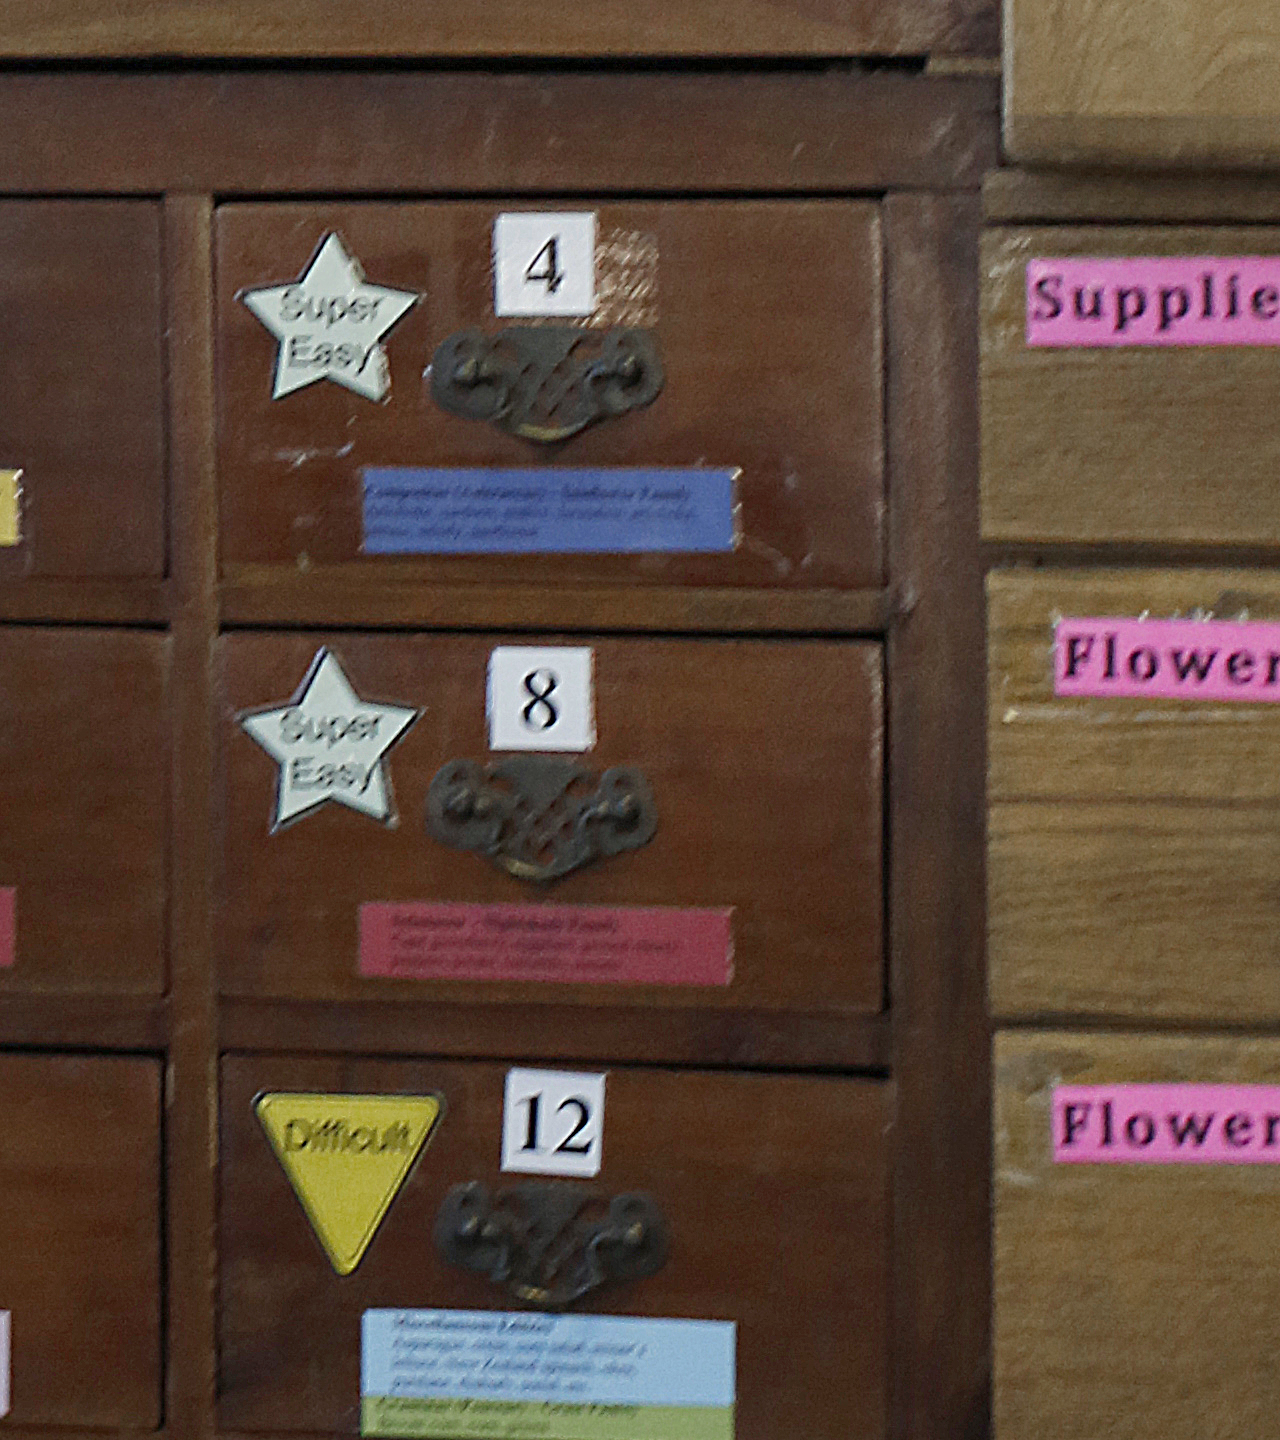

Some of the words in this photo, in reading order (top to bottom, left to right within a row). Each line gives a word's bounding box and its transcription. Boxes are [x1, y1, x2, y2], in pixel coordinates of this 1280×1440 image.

[521, 233, 568, 296] 4
[279, 284, 384, 325] Super
[286, 333, 374, 375] Easy
[519, 667, 560, 732] 8
[279, 710, 382, 750] Super
[290, 756, 377, 796] Easy
[282, 1117, 415, 1156] Difficult
[513, 1089, 596, 1156] 12
